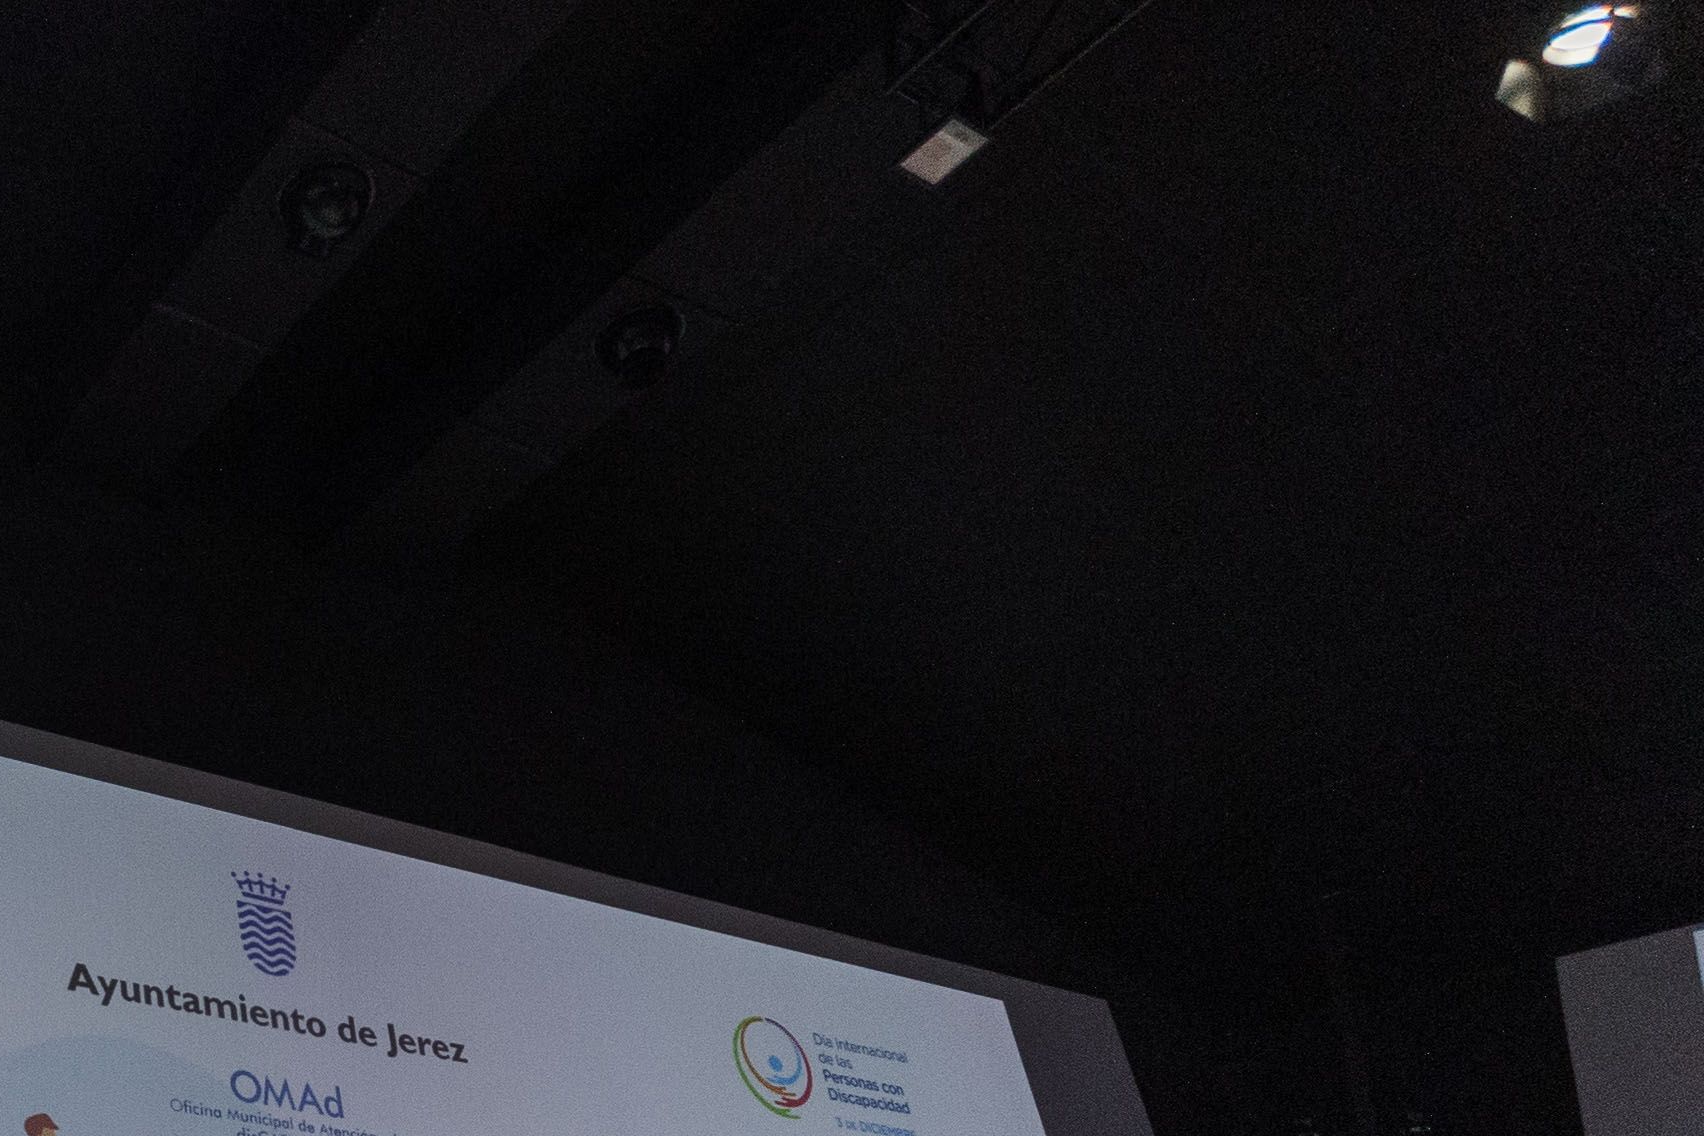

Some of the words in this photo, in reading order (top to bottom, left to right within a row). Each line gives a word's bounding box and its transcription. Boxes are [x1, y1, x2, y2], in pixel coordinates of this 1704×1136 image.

[67, 962, 326, 1038] Ayuntamiento
[337, 1016, 377, 1047] de
[386, 1022, 469, 1064] Jerez
[836, 1055, 853, 1069] las
[230, 1070, 345, 1119] OMAd
[823, 1069, 879, 1092] Personas
[881, 1083, 905, 1096] con
[170, 1098, 222, 1119] Oficina
[227, 1108, 294, 1130] Municipal
[298, 1119, 316, 1134] de
[827, 1087, 911, 1114] Discapacidad
